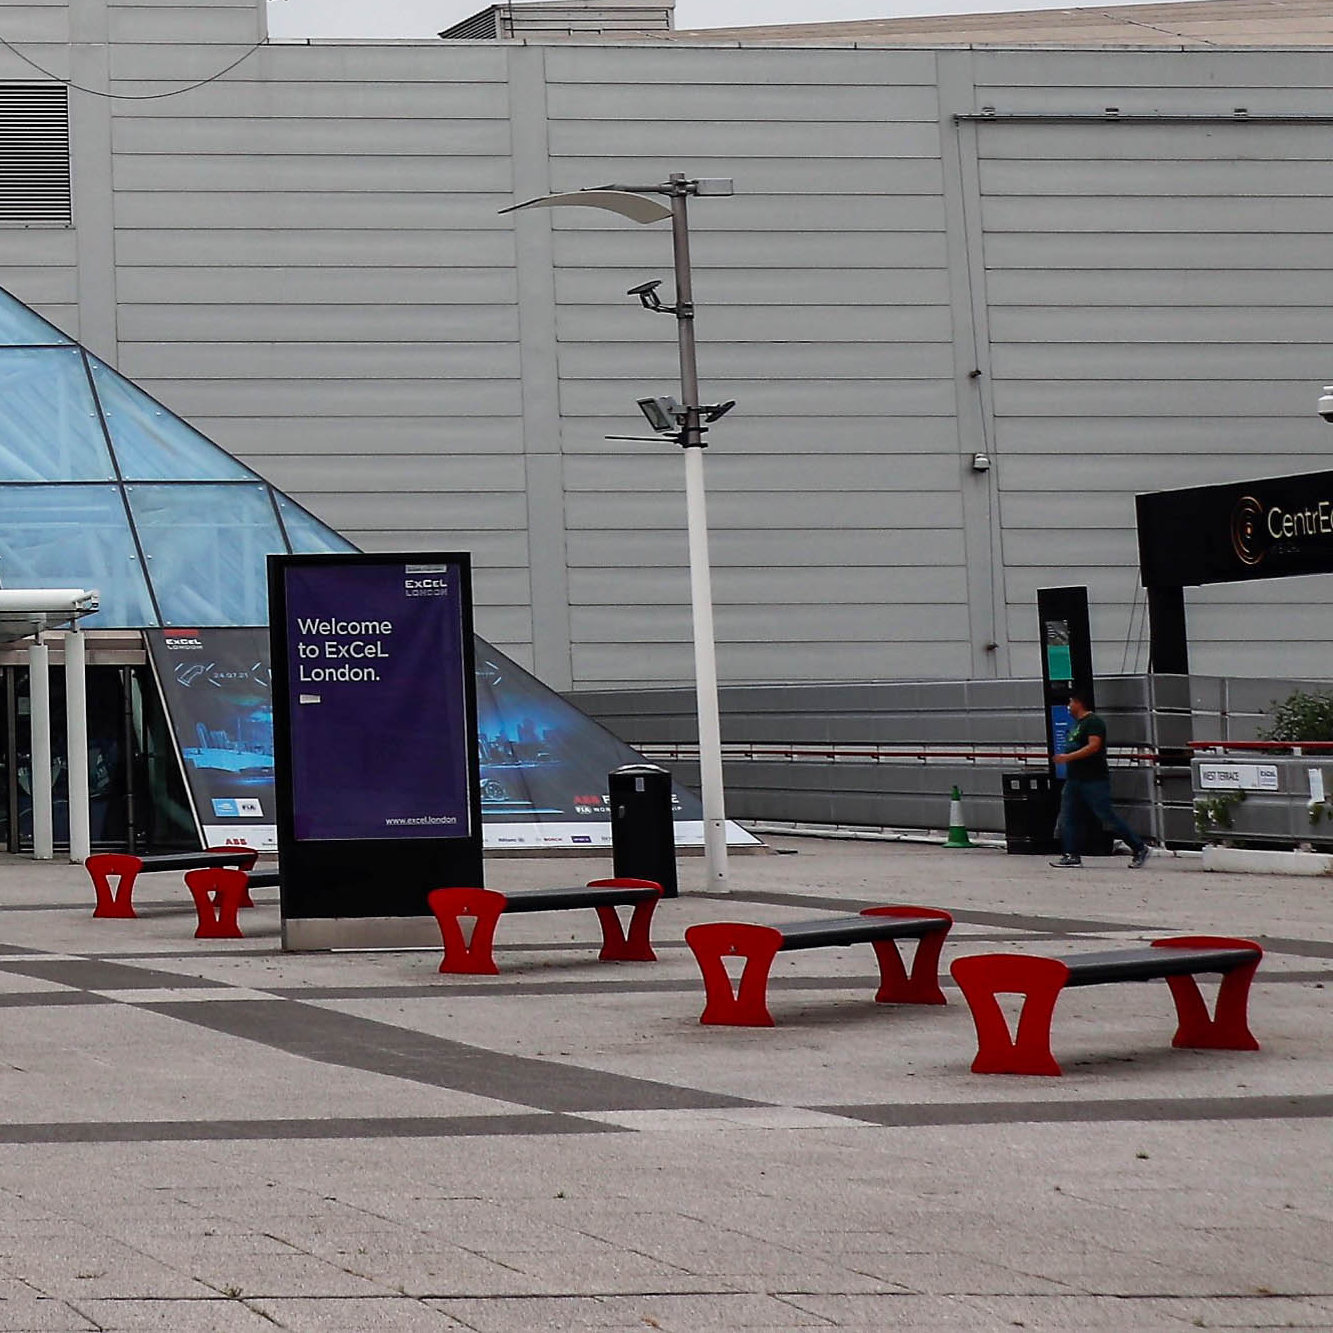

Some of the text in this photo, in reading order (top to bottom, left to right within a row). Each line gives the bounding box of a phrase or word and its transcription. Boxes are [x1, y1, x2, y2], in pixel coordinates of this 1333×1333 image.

[1268, 502, 1333, 538] CentrE
[297, 618, 393, 635] Welcome
[298, 641, 389, 659] to ExCeL
[300, 664, 380, 681] London.
